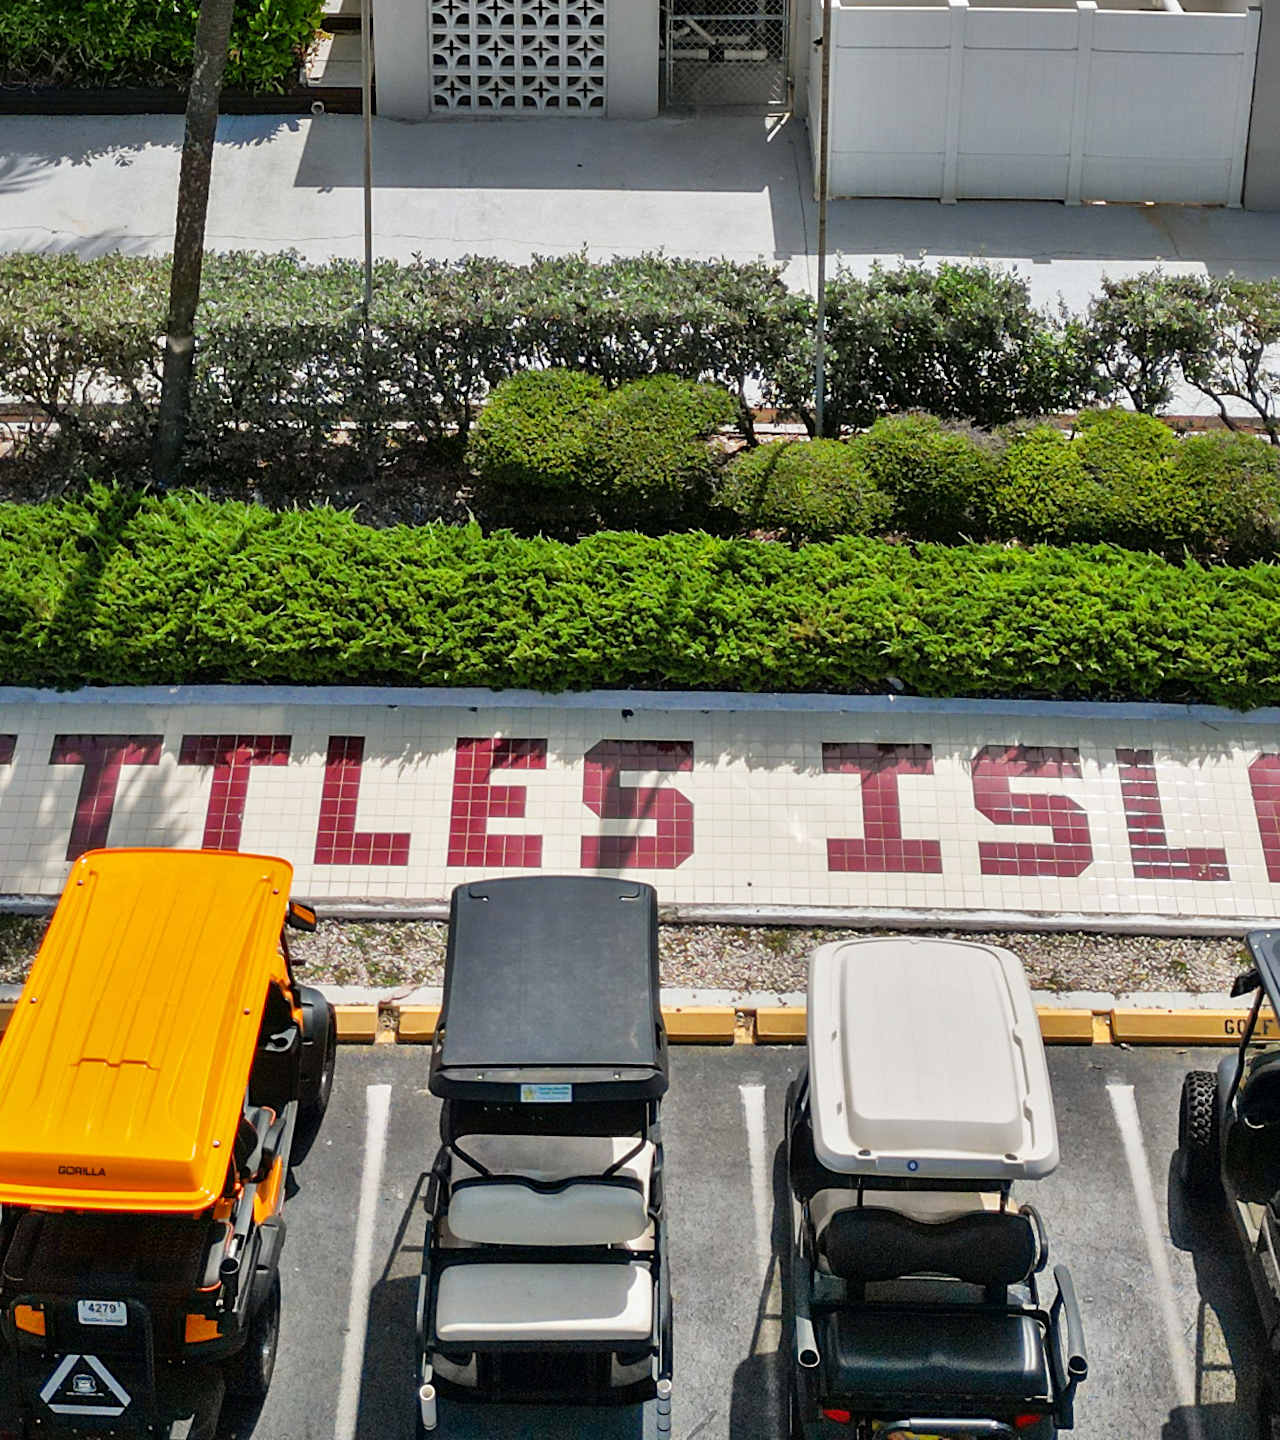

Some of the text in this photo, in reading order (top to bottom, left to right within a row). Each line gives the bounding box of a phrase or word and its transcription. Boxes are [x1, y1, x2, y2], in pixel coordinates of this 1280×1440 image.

[1224, 1018, 1273, 1035] GOF
[58, 1165, 107, 1177] GORILLA
[87, 1303, 117, 1314] 4279
